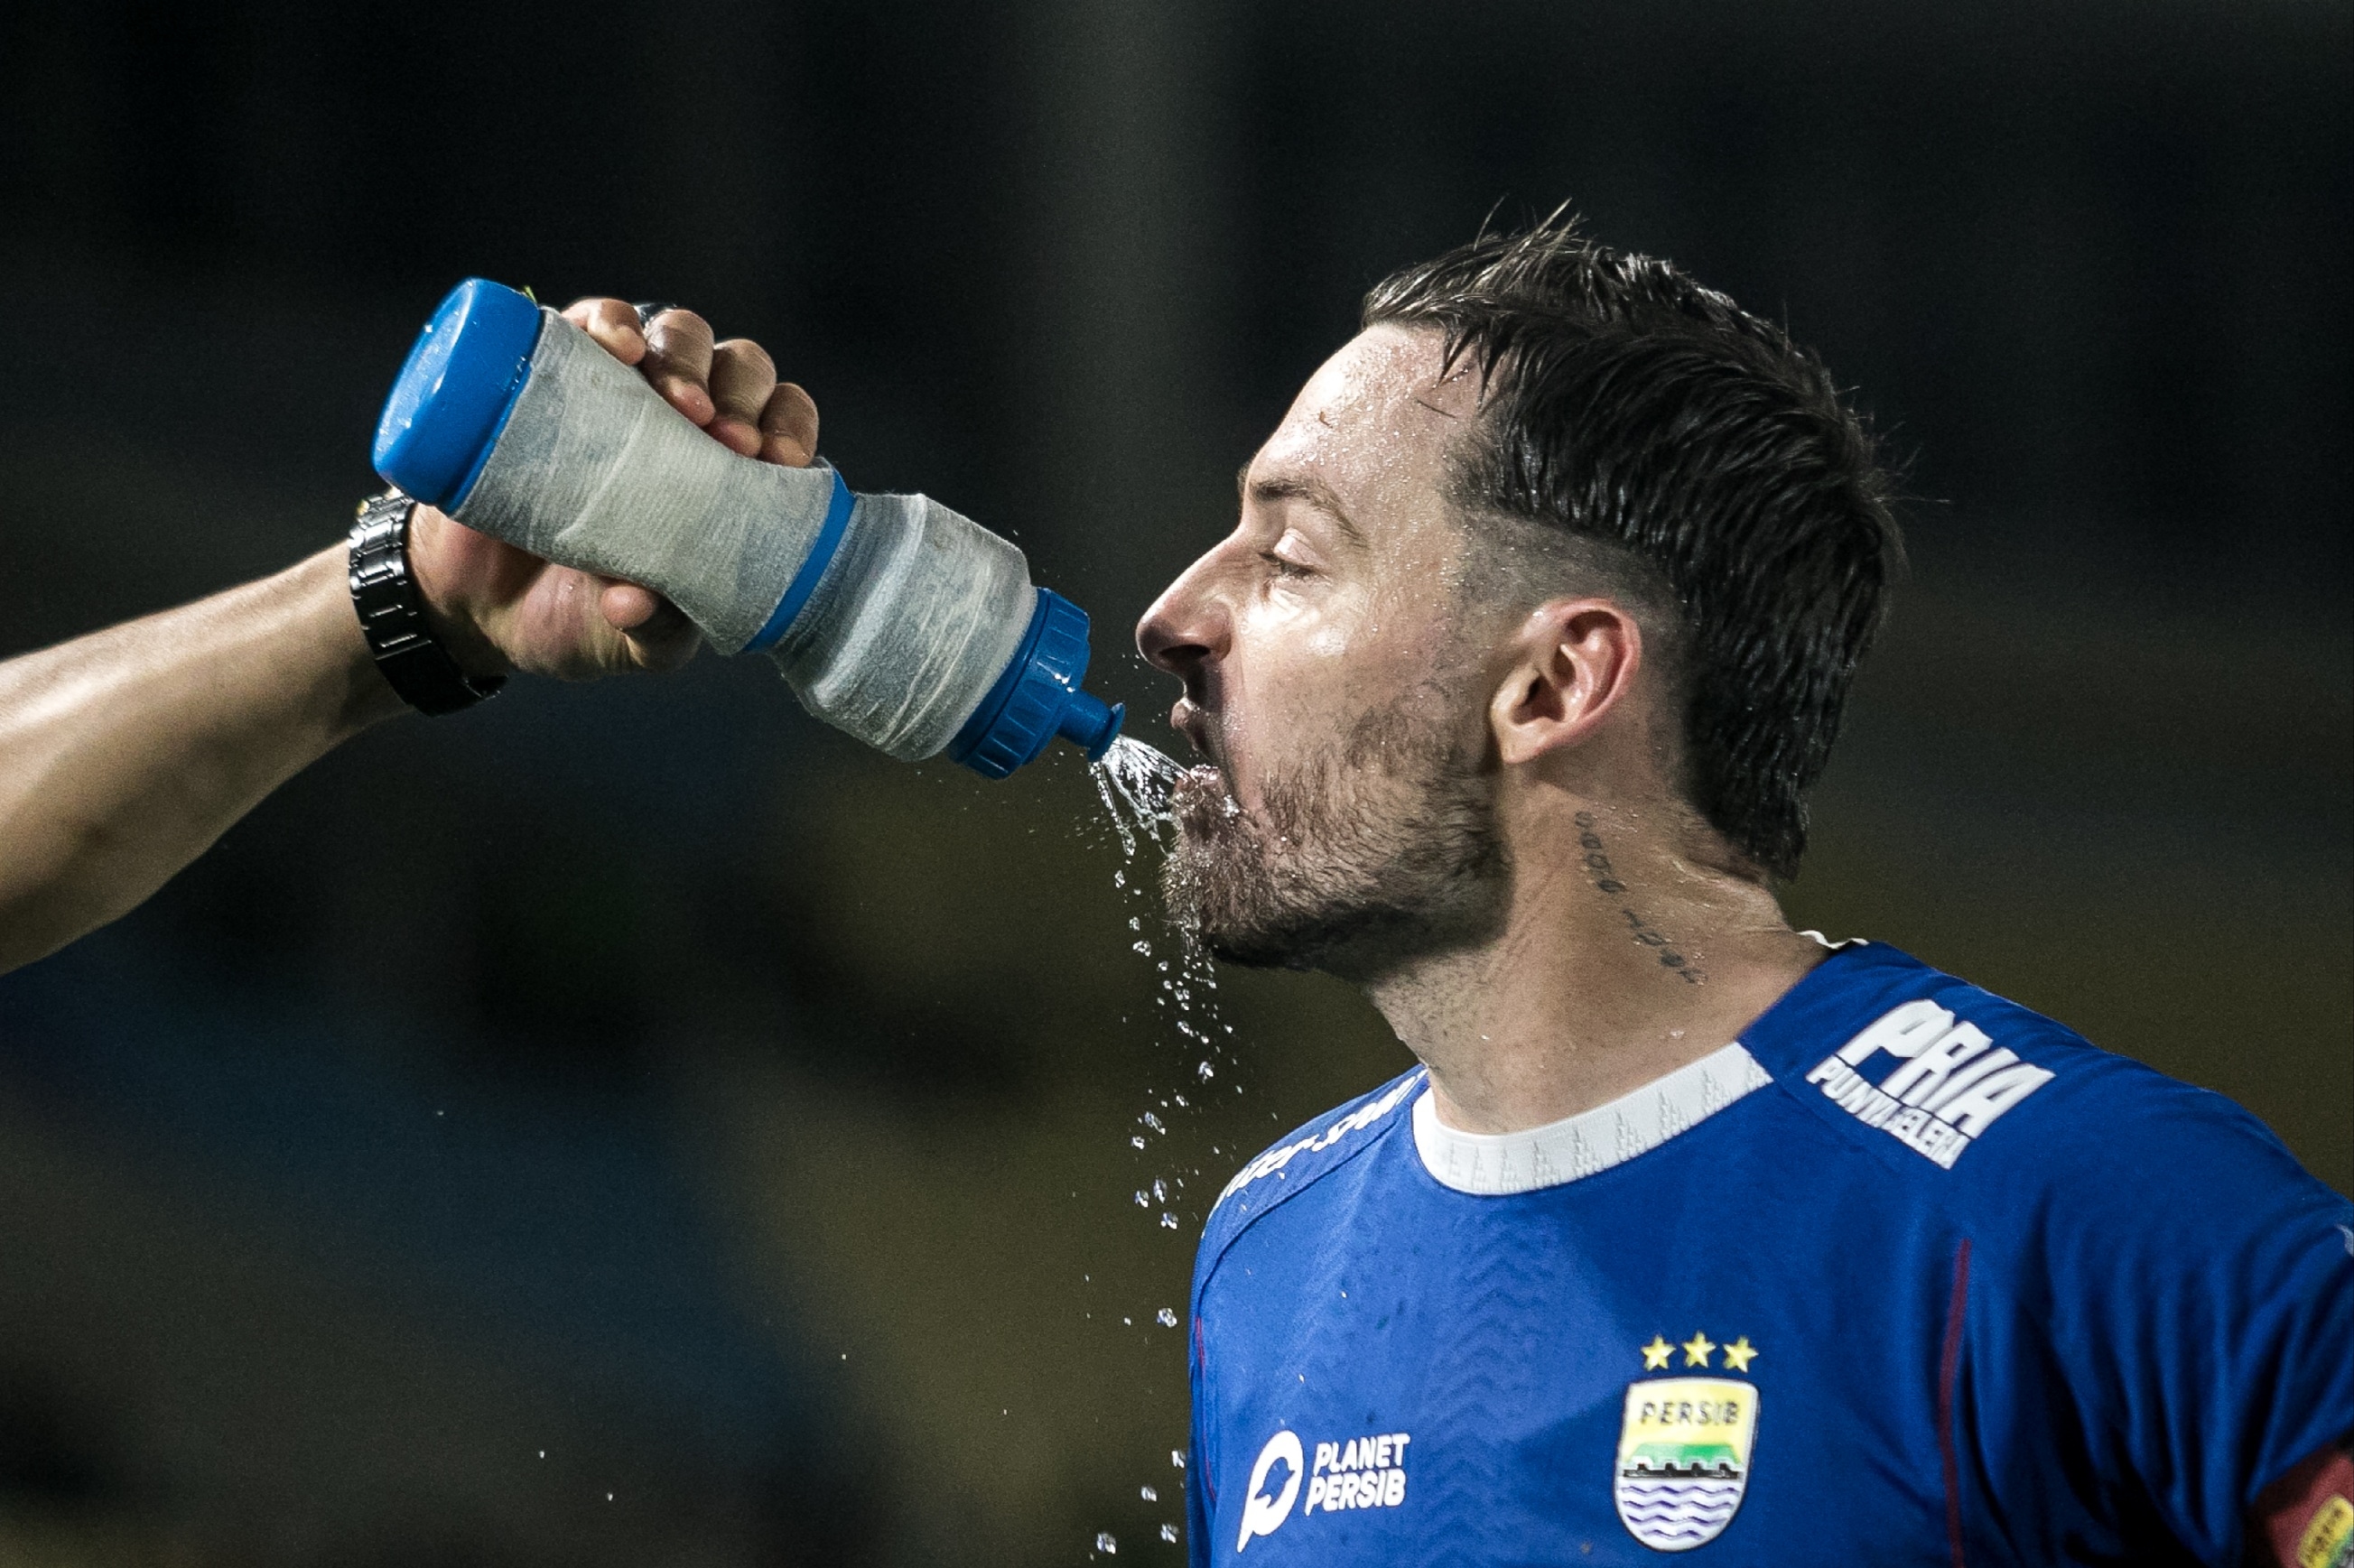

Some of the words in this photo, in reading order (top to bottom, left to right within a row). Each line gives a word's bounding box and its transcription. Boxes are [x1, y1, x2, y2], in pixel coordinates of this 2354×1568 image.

[1833, 998, 2056, 1139] PRIA
[1640, 1401, 1740, 1426] PERSIB
[1313, 1433, 1410, 1476] PLANET
[1305, 1469, 1406, 1516] PERSIB
